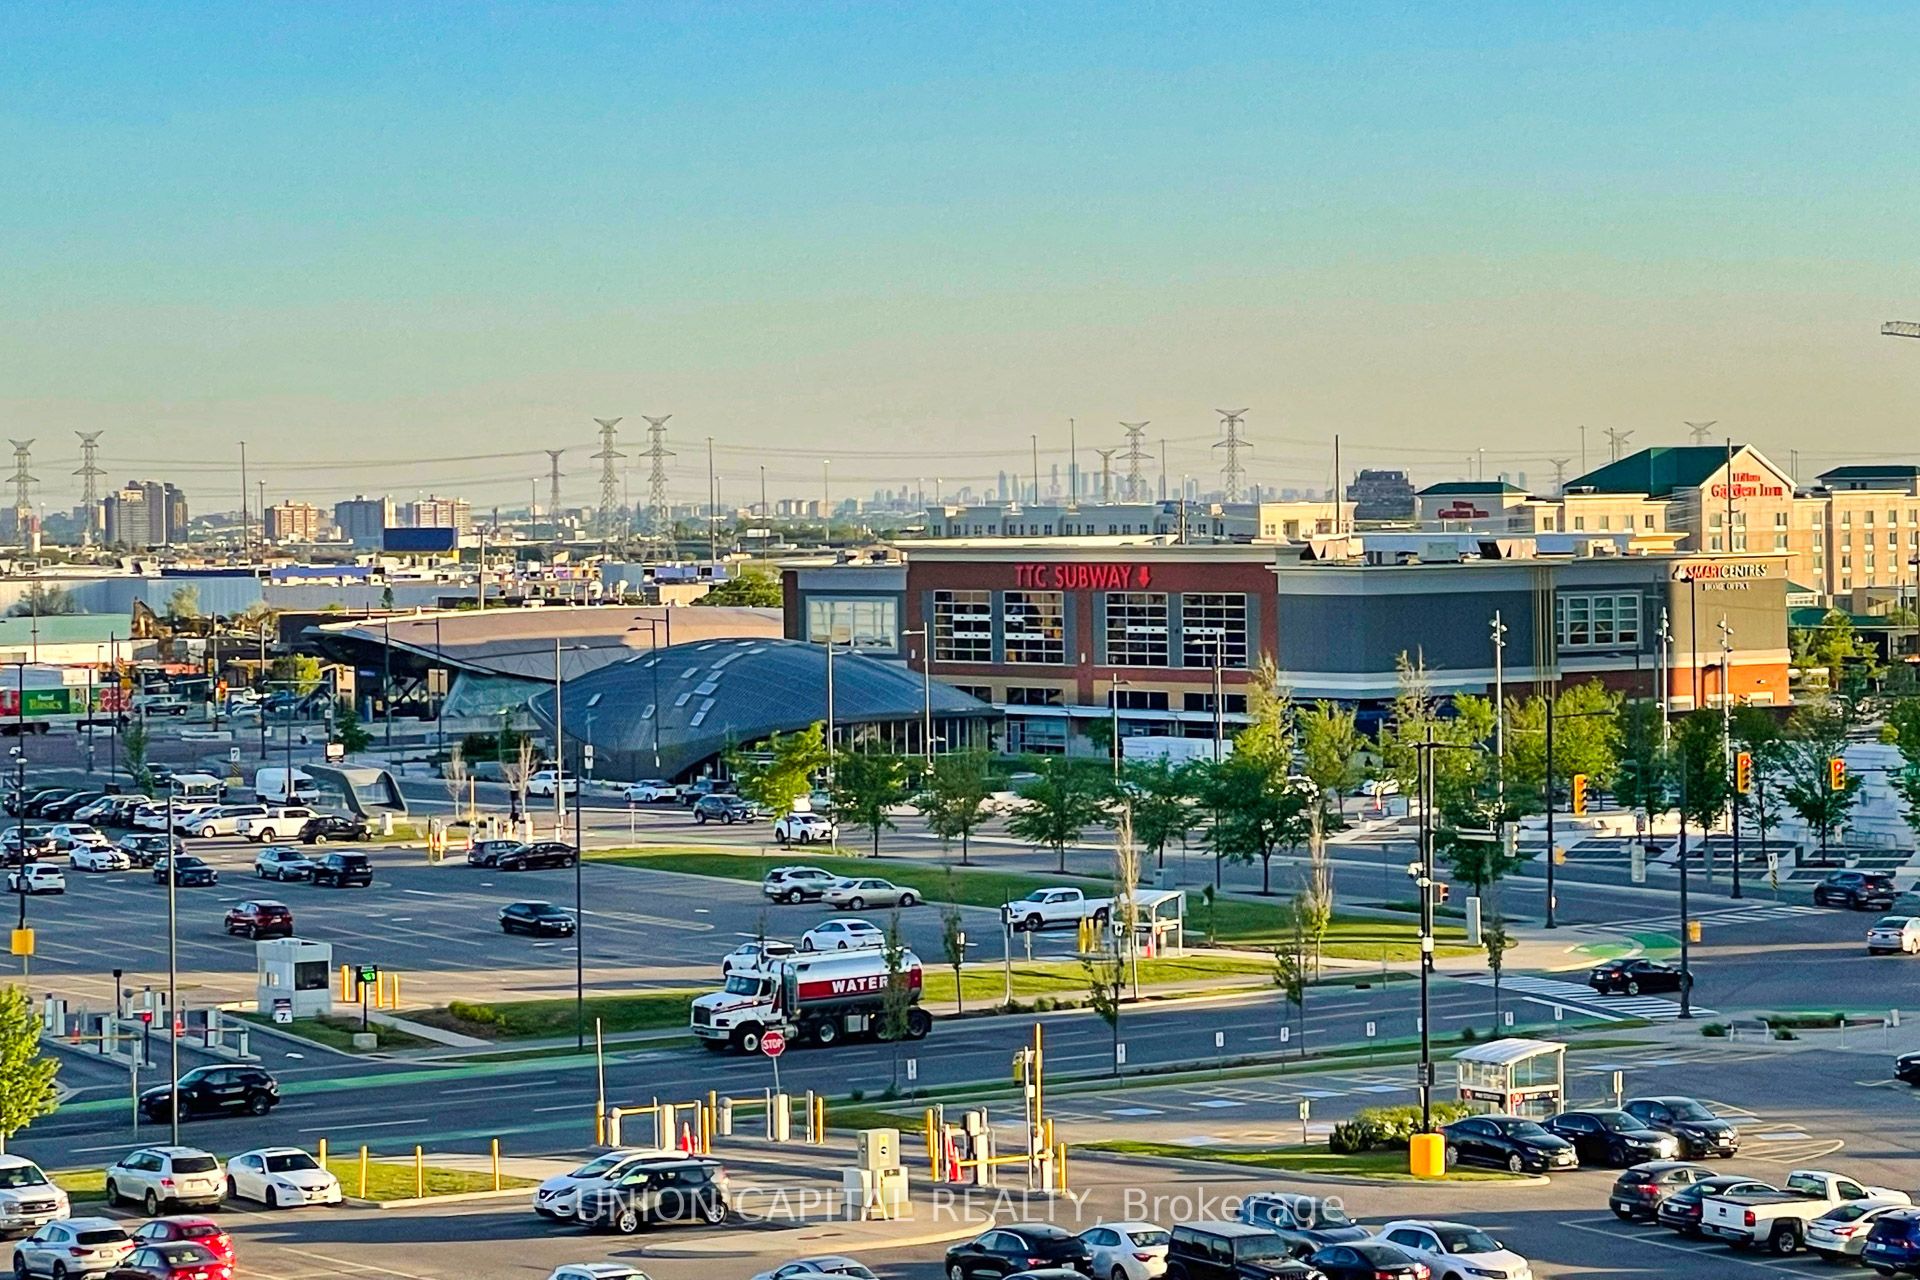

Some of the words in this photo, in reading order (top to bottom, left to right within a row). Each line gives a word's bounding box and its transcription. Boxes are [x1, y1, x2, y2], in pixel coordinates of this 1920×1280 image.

[1014, 565, 1048, 588] TTC
[1054, 564, 1133, 588] SUBWAY
[831, 975, 889, 994] WATER
[762, 1038, 783, 1051] STOP
